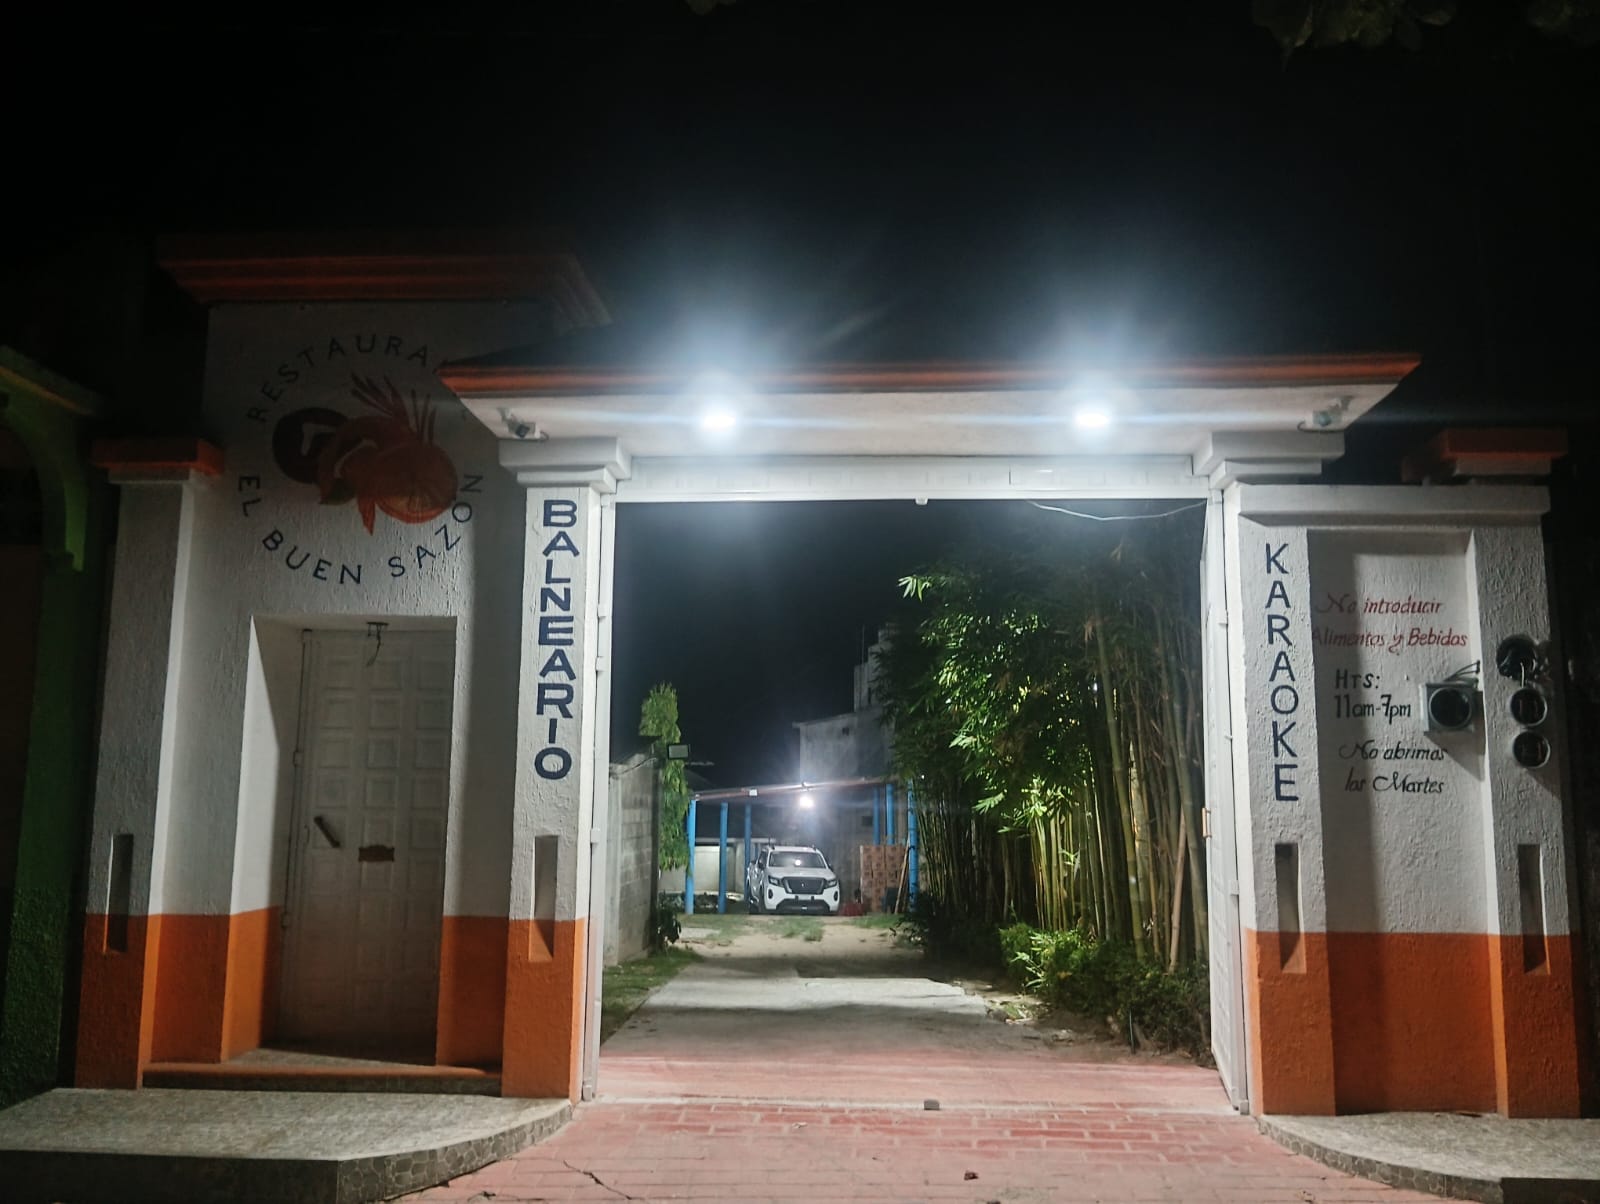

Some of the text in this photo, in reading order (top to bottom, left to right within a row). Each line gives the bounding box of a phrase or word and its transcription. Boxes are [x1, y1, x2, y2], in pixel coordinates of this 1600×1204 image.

[247, 335, 445, 424] RESTAURA
[239, 474, 484, 585] EL BUEN SAZON
[1315, 593, 1444, 615] No introducir
[534, 499, 580, 780] BALNEARIO
[1388, 632, 1403, 654] y
[1407, 627, 1469, 648] Bebidas
[1264, 543, 1299, 802] KARAOKE
[1338, 739, 1448, 761] No abrimos
[1373, 771, 1445, 794] Martes
